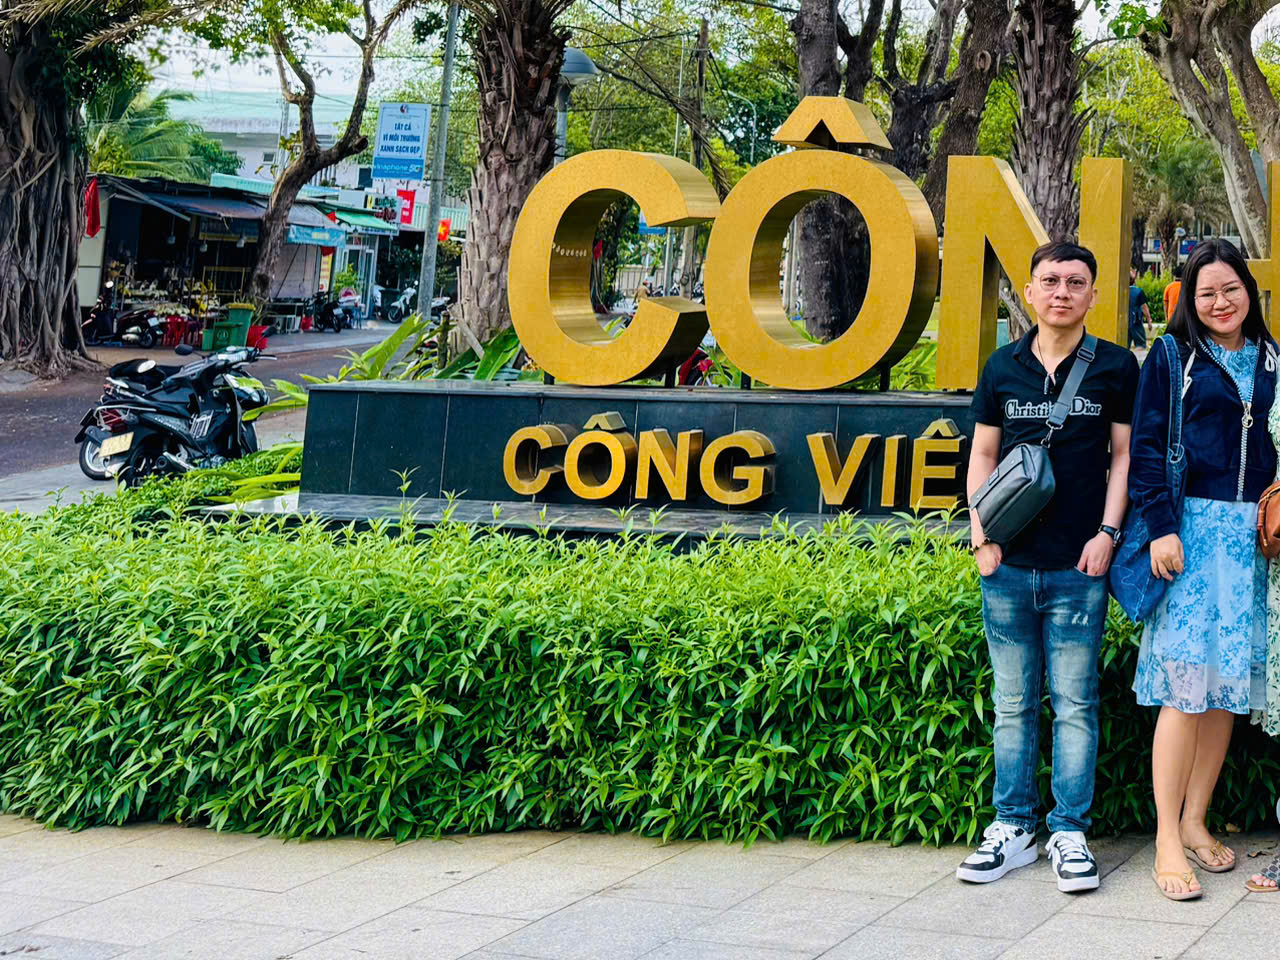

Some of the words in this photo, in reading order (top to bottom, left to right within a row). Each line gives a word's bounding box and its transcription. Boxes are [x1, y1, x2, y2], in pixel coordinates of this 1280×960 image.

[508, 96, 1131, 391] CÔN
[1005, 399, 1055, 419] Christi
[1069, 396, 1102, 416] Dior
[503, 411, 776, 506] CÔNG
[806, 418, 968, 509] VIÊ
